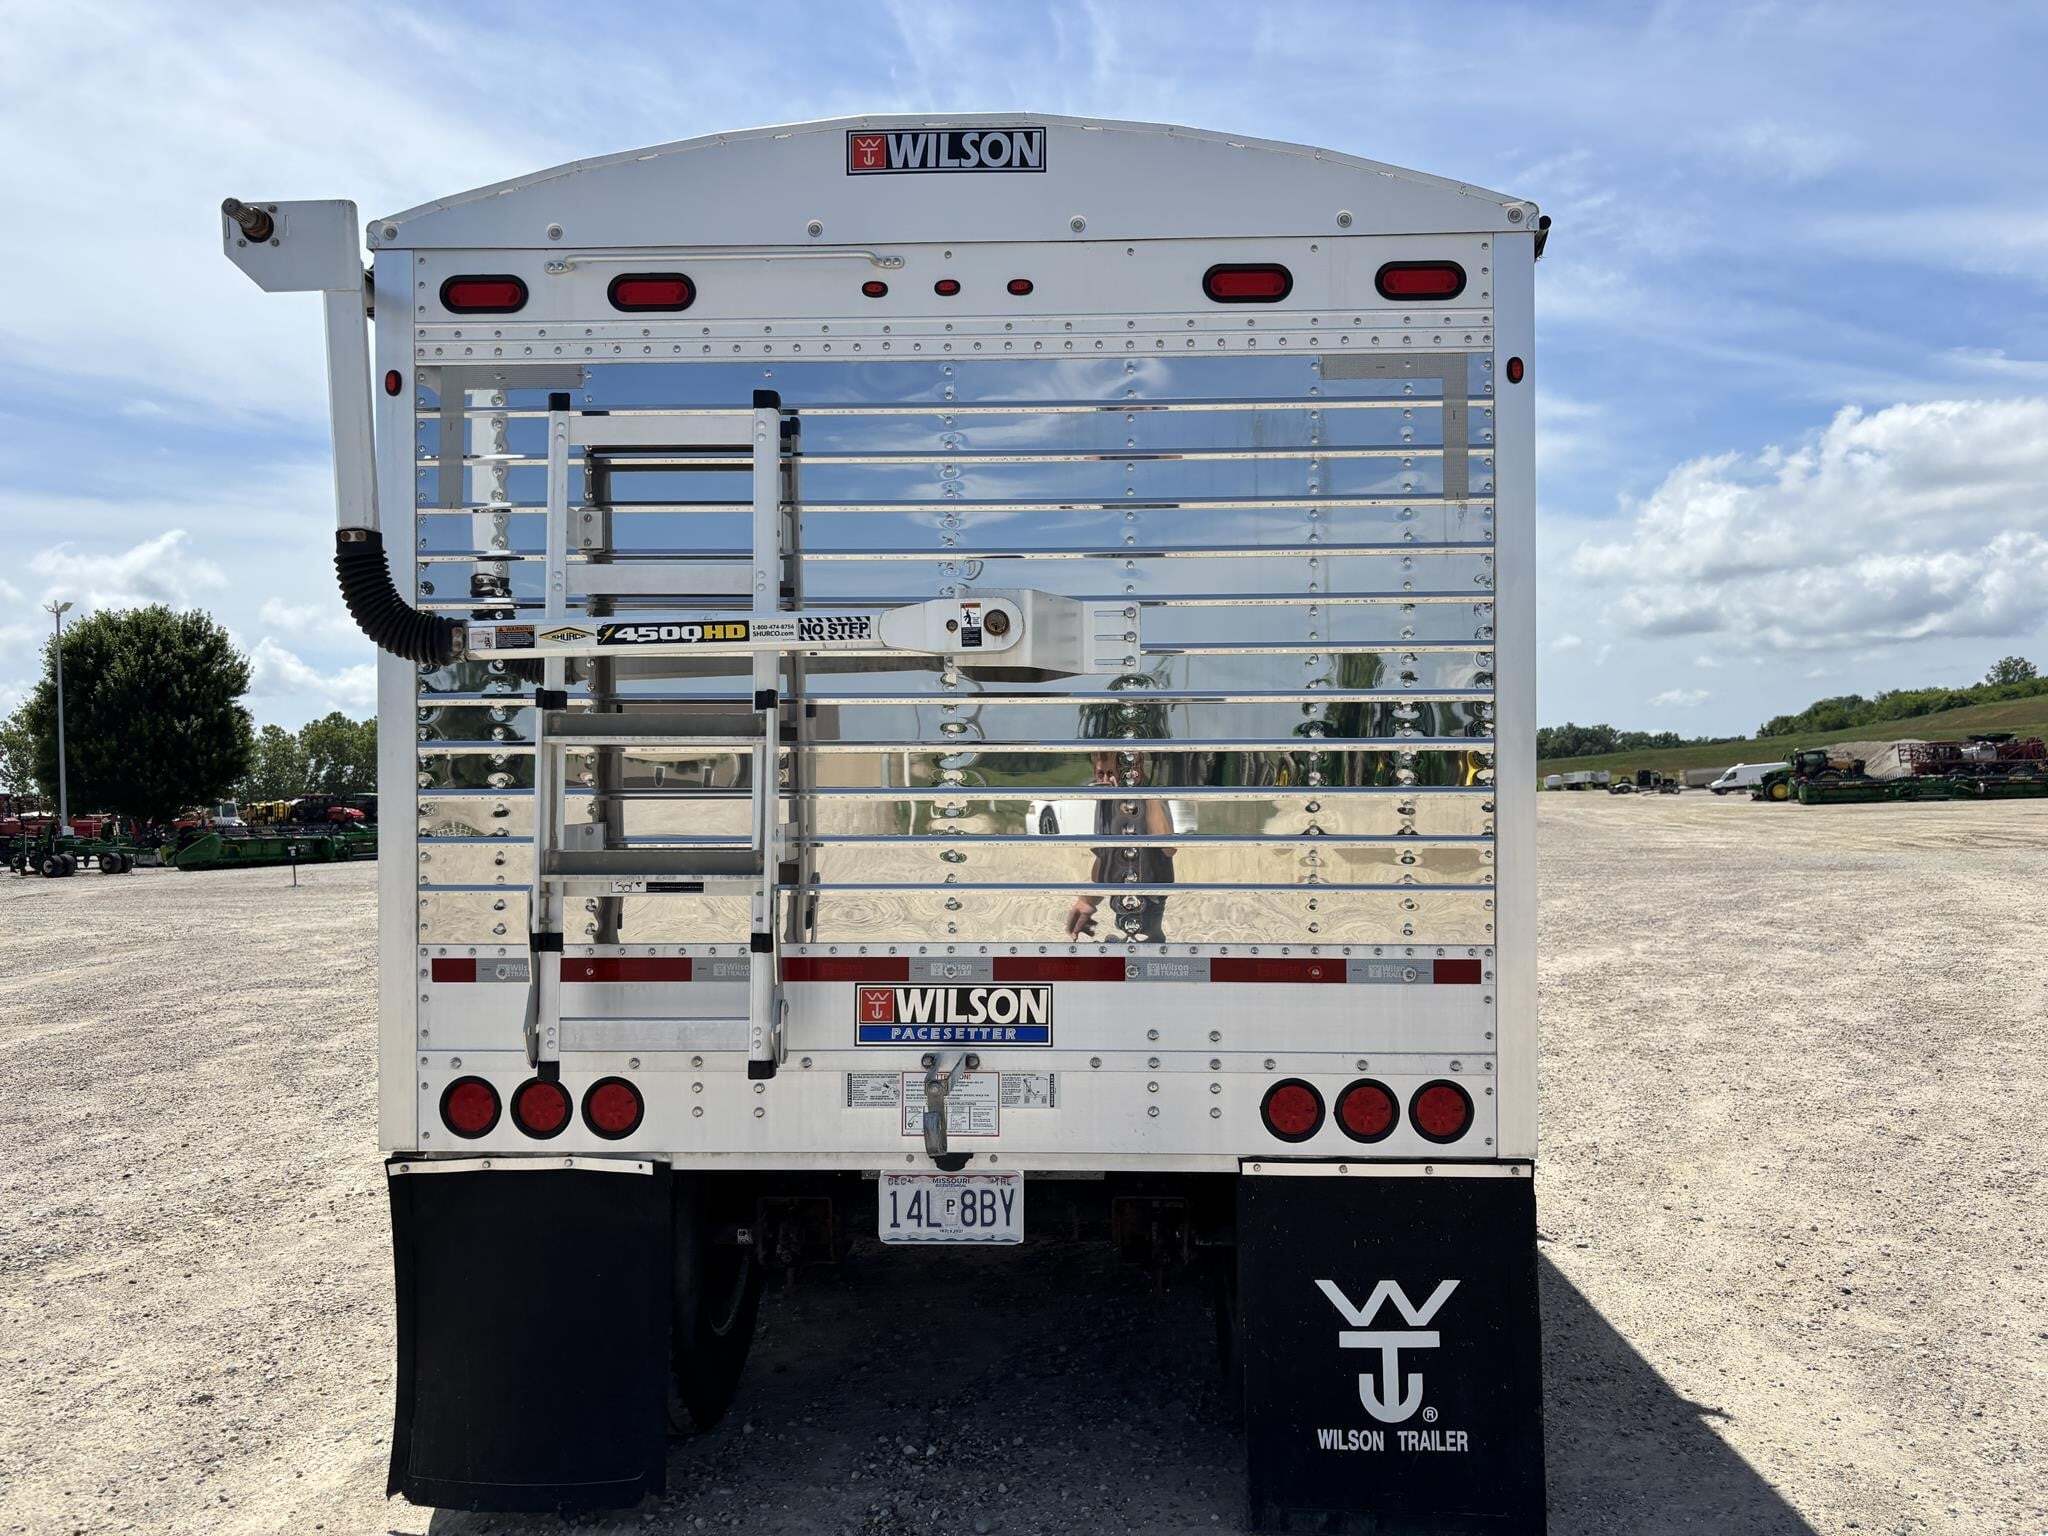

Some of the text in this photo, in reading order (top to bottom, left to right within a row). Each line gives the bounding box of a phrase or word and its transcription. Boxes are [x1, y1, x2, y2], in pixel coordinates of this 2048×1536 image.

[886, 131, 1041, 169] WILSON
[800, 622, 869, 636] NO STEP
[896, 988, 1047, 1024] WILSON
[891, 1027, 1016, 1040] PACESETTER
[890, 1190, 942, 1228] 14L
[960, 1188, 1015, 1228] 8BY
[1317, 1429, 1469, 1453] WILSON TRAILER
